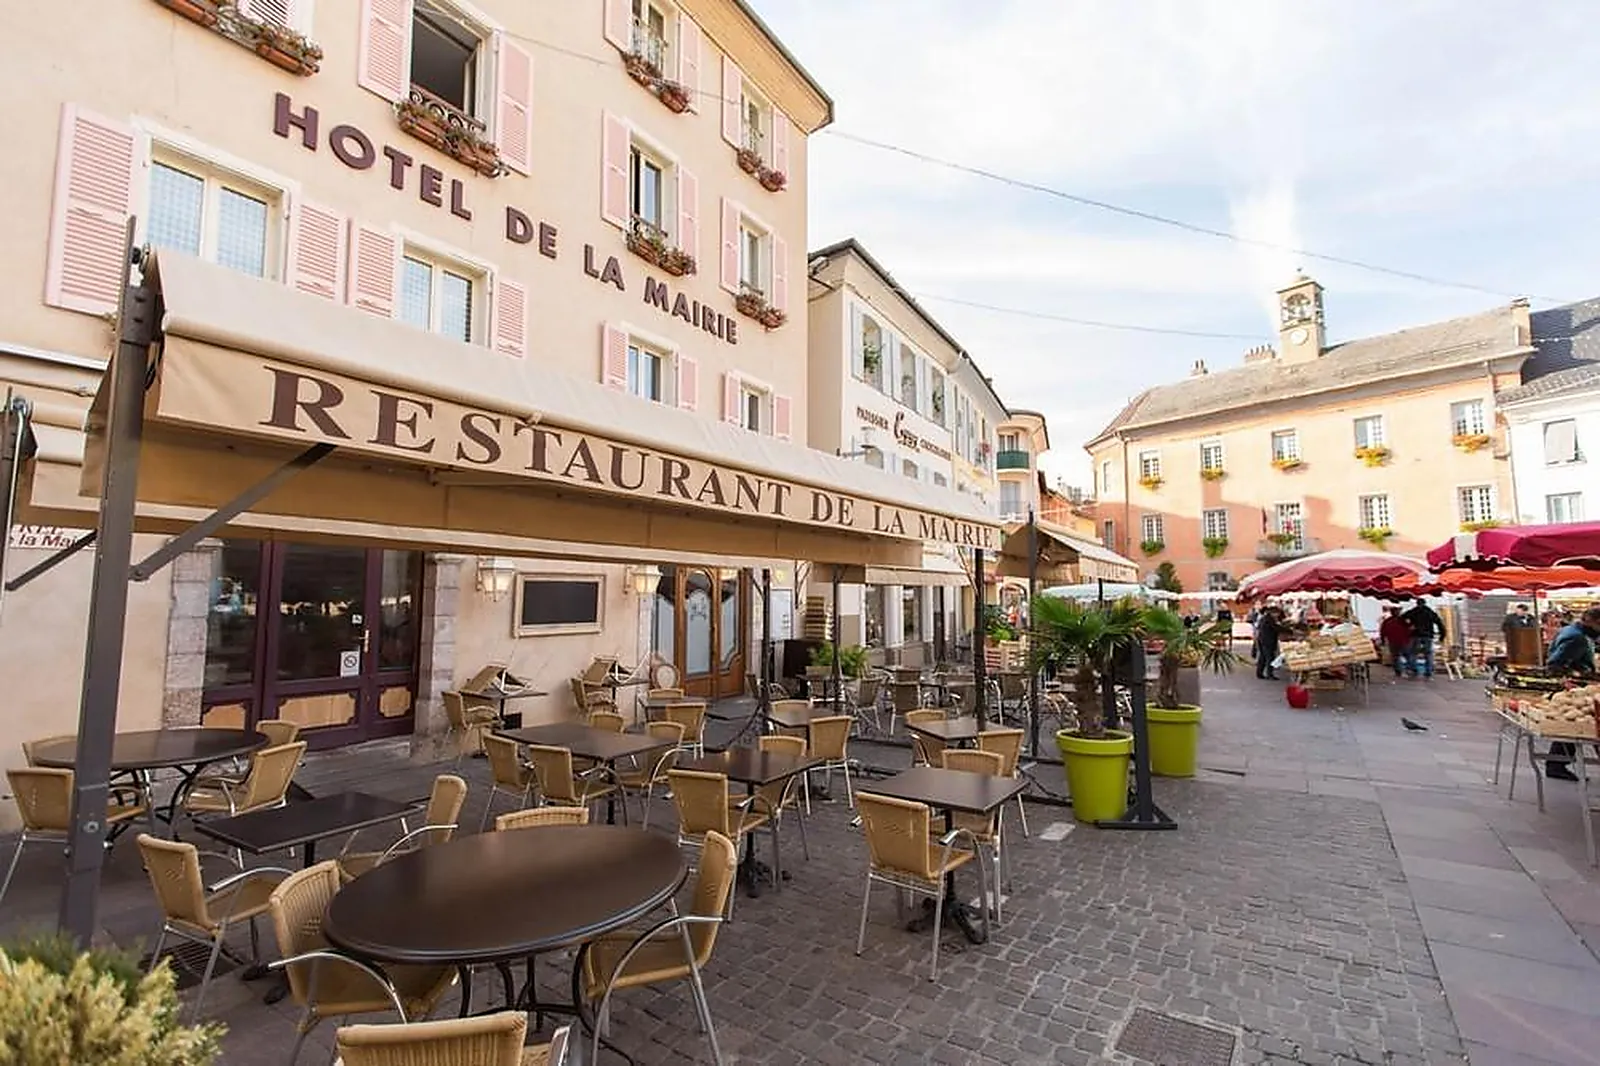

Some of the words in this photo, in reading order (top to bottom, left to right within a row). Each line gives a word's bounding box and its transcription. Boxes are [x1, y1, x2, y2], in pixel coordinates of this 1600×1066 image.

[273, 92, 472, 221] HOTEL
[506, 206, 557, 259] DE
[584, 244, 625, 291] LA
[643, 276, 737, 345] MAIRIE
[259, 365, 791, 516] RESTAURANT
[810, 491, 854, 526] DE
[873, 505, 906, 534] LA
[919, 514, 993, 549] MAIRIE
